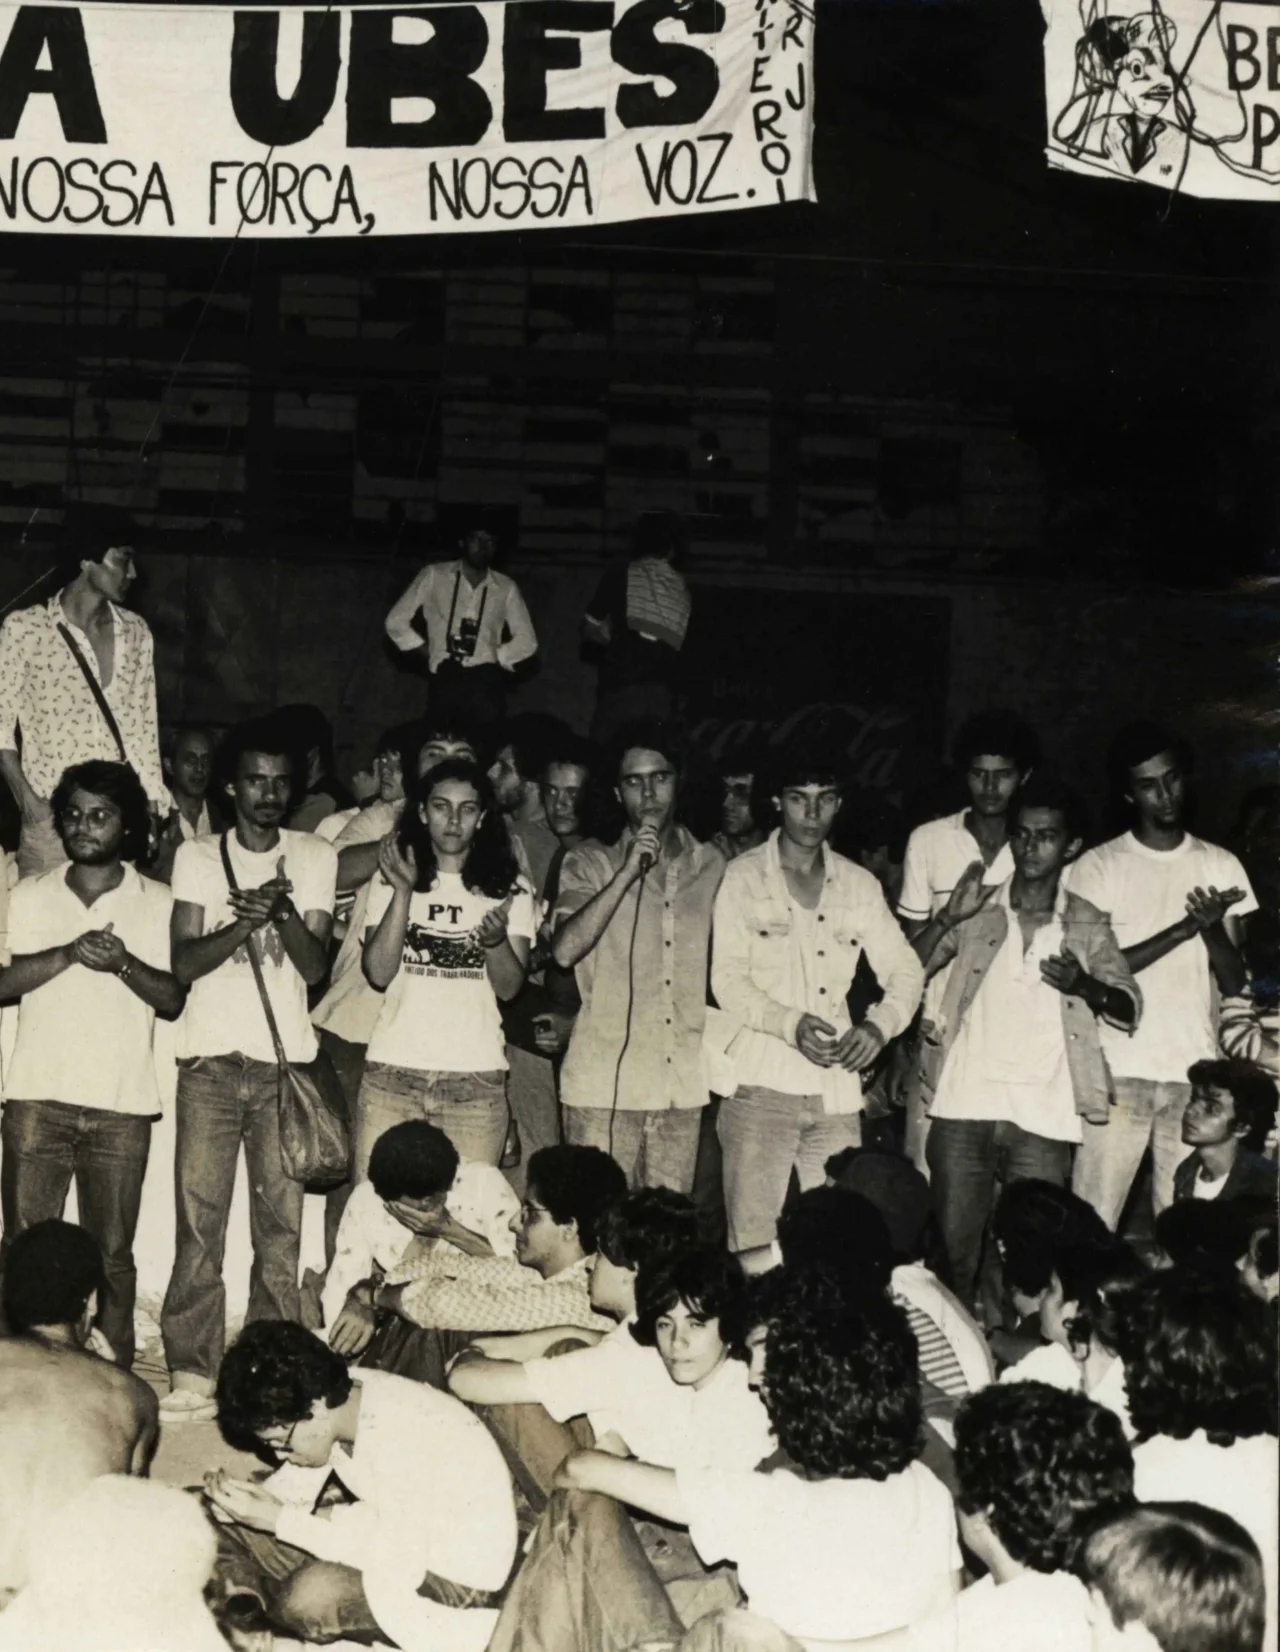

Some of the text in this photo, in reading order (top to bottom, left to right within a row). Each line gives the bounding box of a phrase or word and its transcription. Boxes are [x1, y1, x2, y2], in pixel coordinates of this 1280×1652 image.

[230, 0, 726, 148] UBES
[209, 161, 377, 234] FORÇA,
[429, 155, 594, 221] NOSSA
[636, 132, 756, 206] VOZ.
[427, 903, 463, 924] PT
